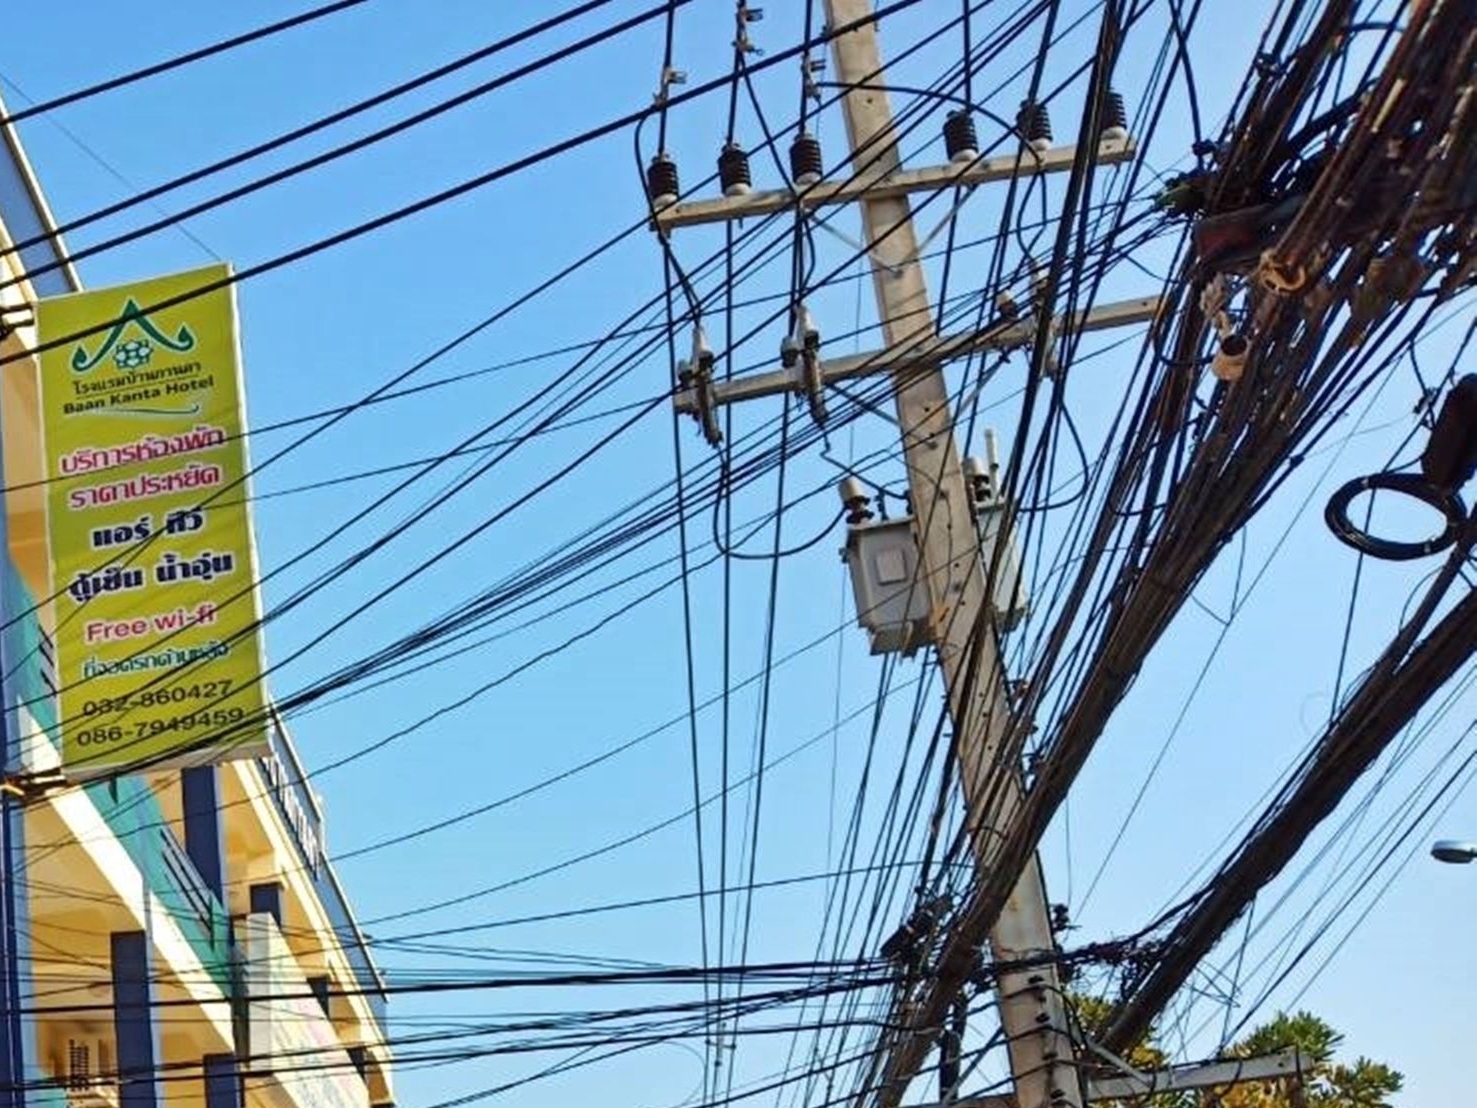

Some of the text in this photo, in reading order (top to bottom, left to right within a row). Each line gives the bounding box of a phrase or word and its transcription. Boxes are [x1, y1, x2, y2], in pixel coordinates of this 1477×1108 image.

[63, 374, 215, 415] Baan Kanta Hotel
[61, 427, 225, 474] บริการห้องพัก
[71, 465, 220, 508] ราคาประหยัด
[93, 516, 150, 547] แอร์
[156, 552, 233, 581] น้ำอุ่น
[87, 604, 216, 642] Free wi-fi
